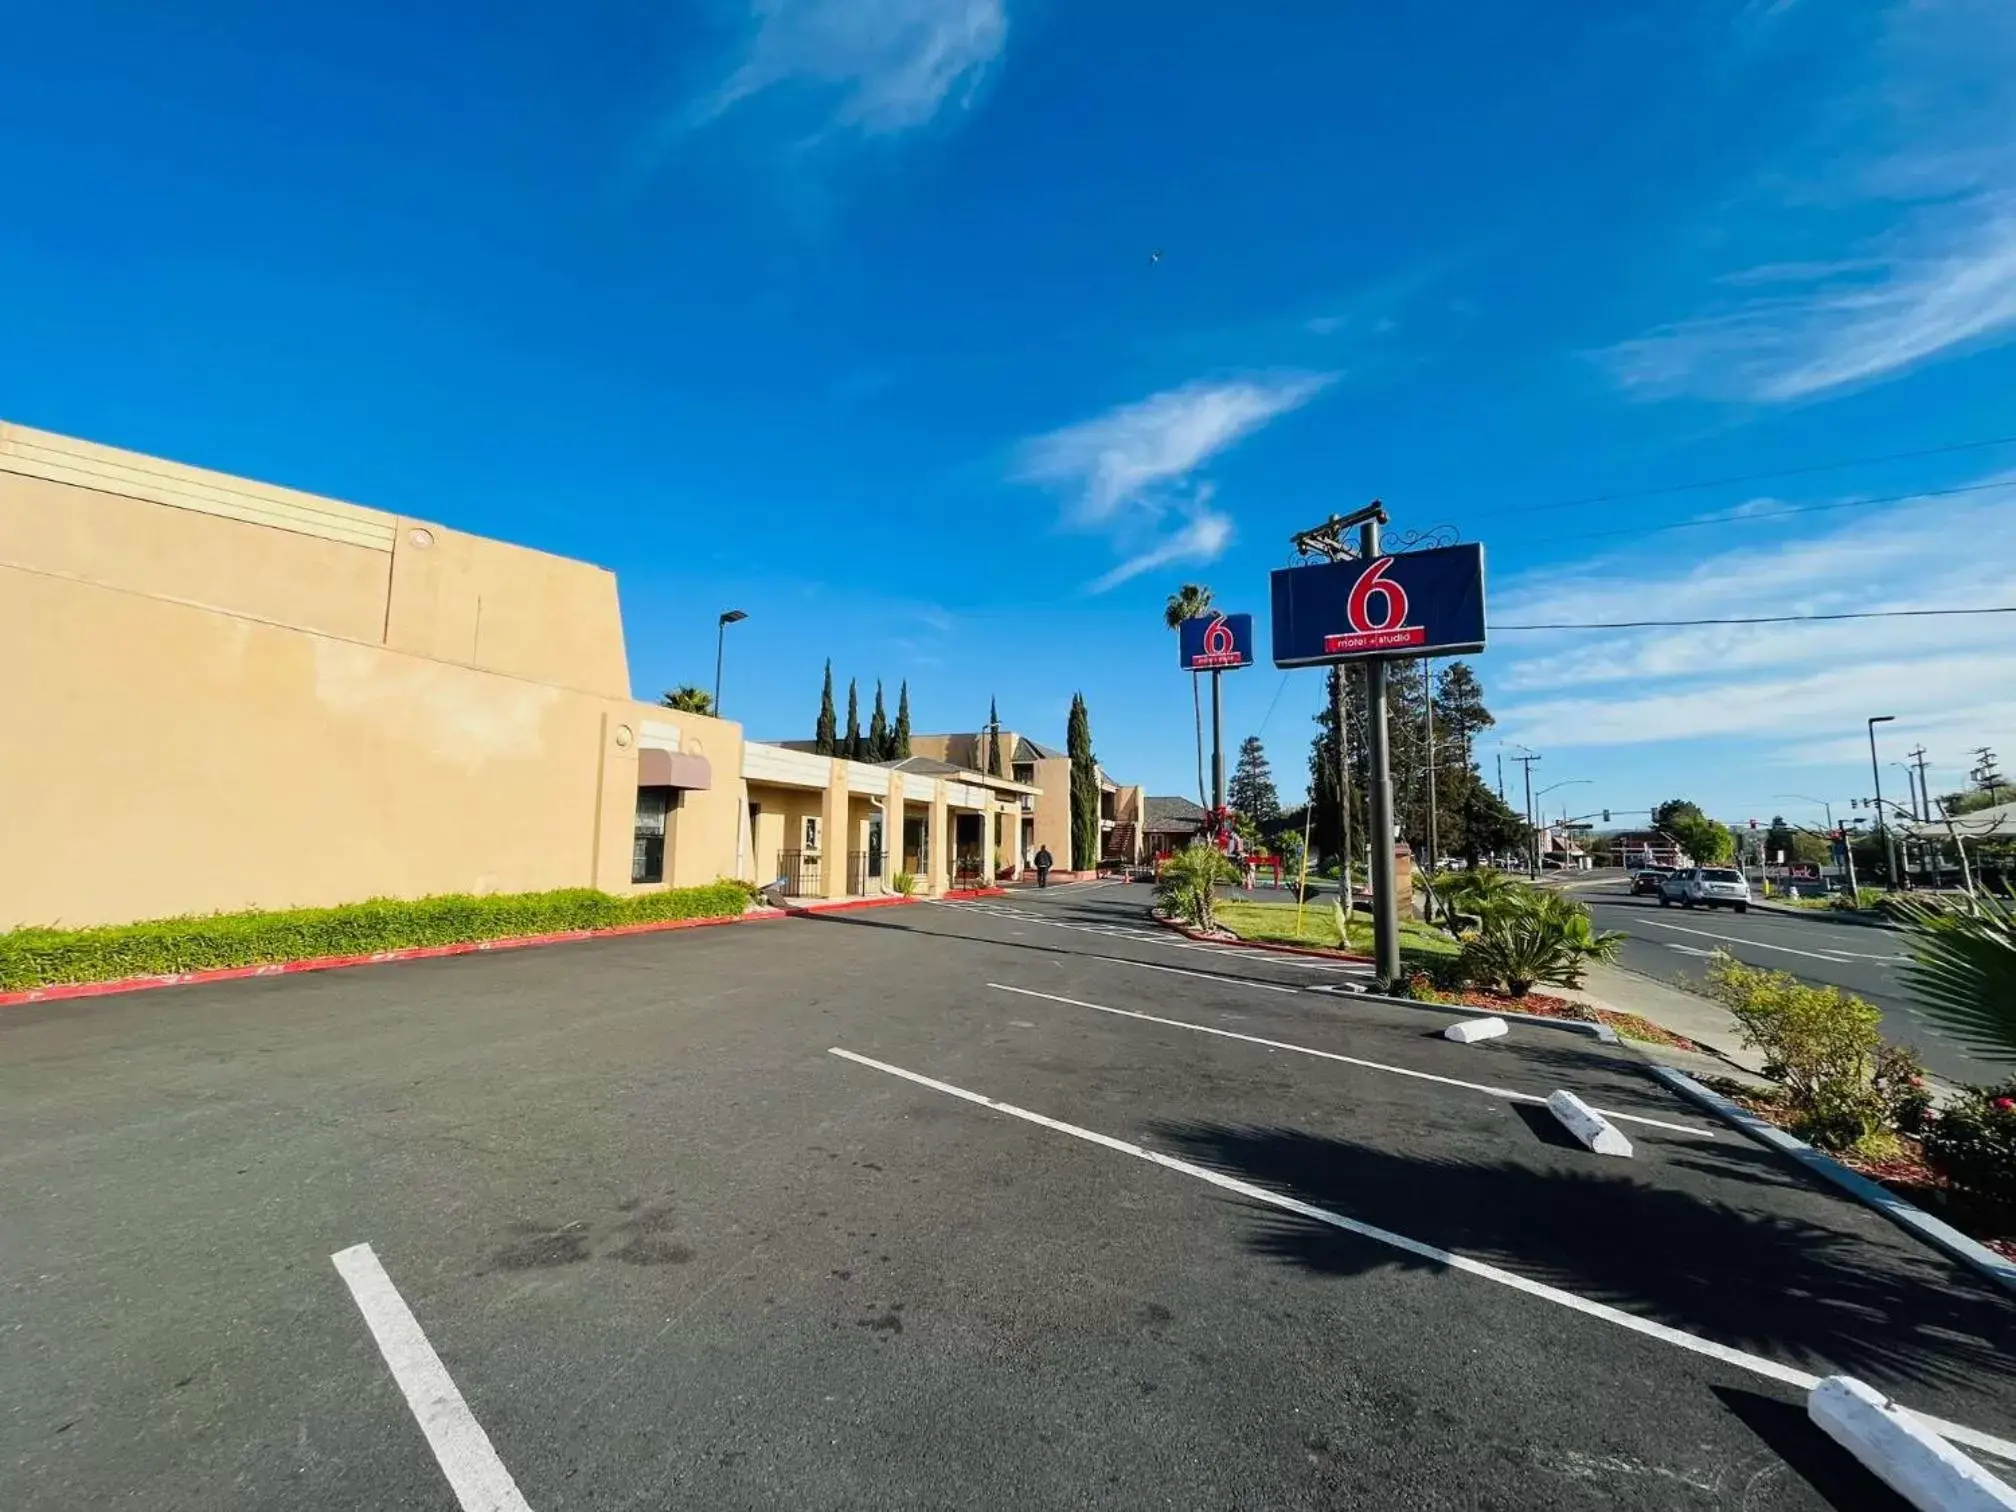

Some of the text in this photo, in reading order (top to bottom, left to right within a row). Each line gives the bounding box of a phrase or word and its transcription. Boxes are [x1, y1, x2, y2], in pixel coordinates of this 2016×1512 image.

[1347, 557, 1408, 633] 6
[1204, 615, 1234, 656] 6
[1337, 636, 1367, 648] motel
[1379, 632, 1411, 643] studio
